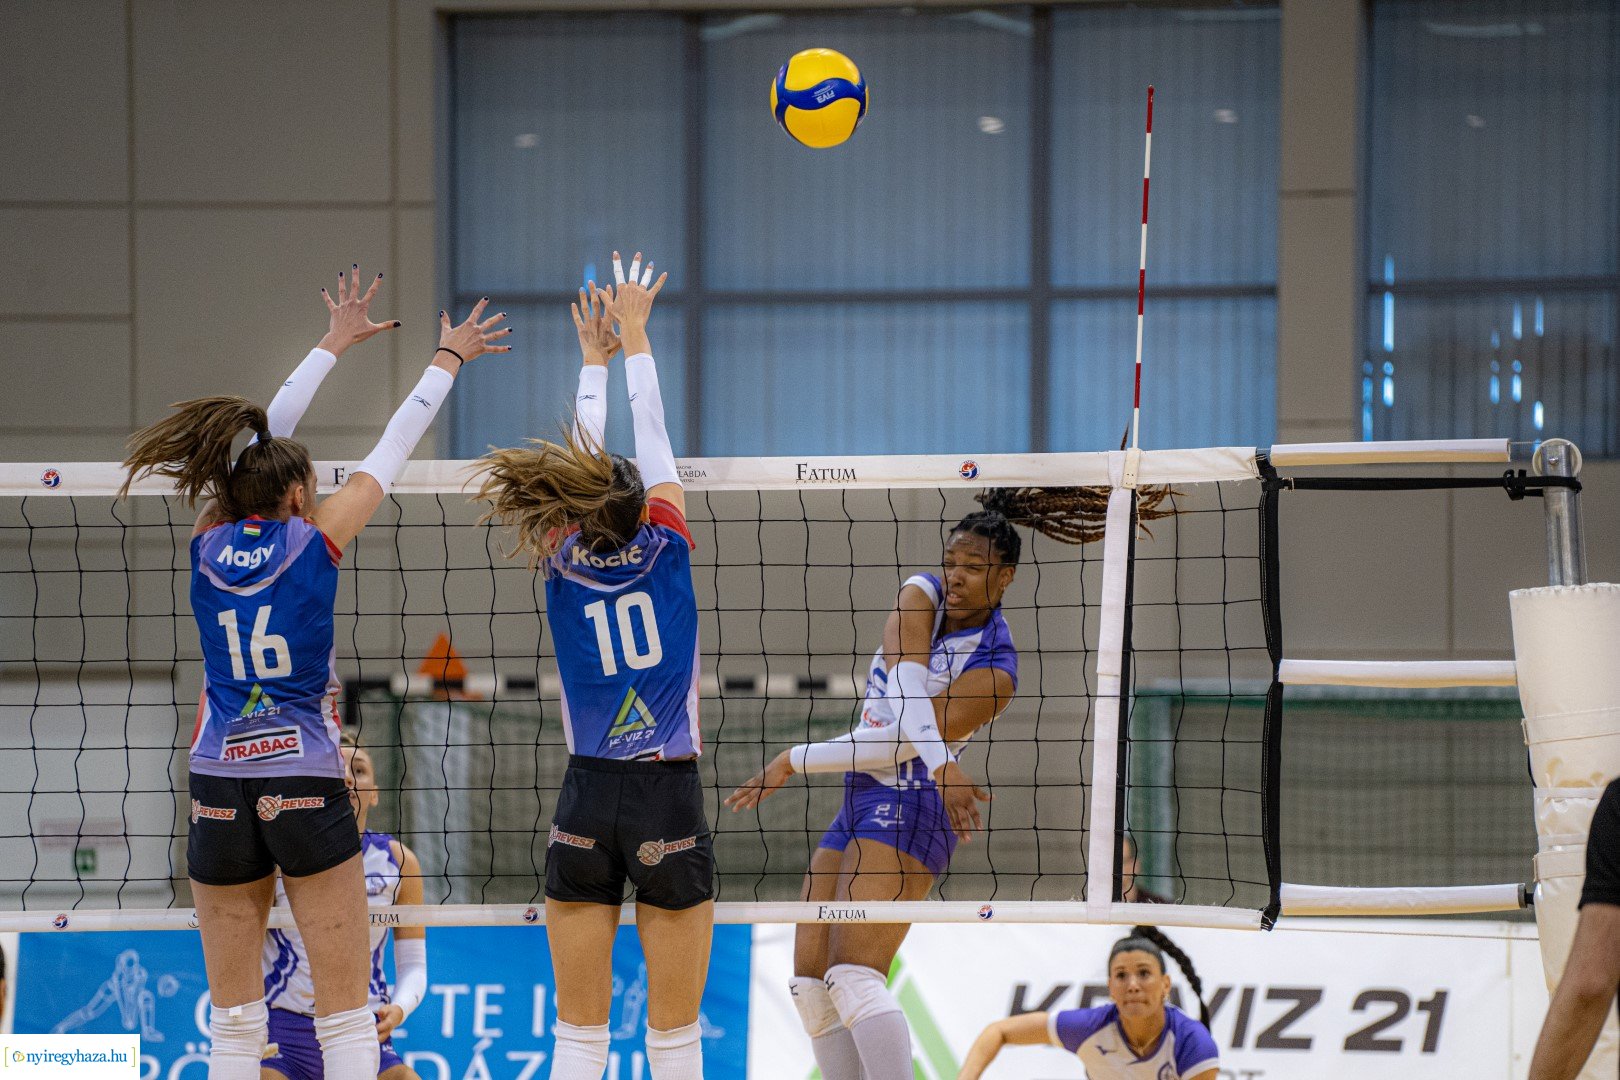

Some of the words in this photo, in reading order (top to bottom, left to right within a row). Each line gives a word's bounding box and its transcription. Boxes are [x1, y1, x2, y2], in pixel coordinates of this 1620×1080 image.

[677, 470, 707, 478] LABDA
[217, 605, 292, 680] 16
[584, 591, 663, 676] 10
[267, 706, 280, 716] 21
[875, 804, 902, 819] 21
[430, 984, 505, 1038] TE
[1344, 990, 1448, 1053] 21
